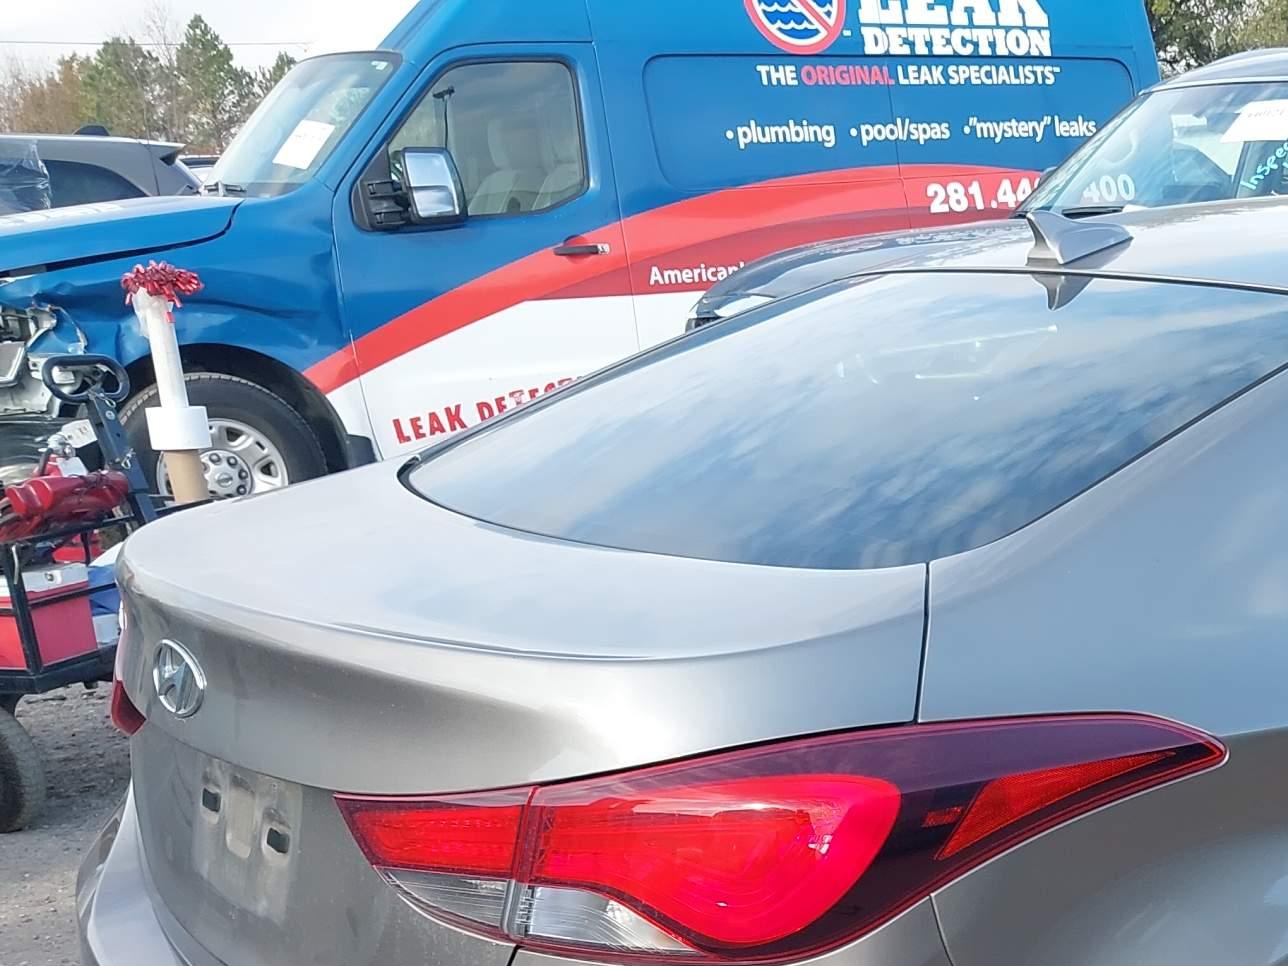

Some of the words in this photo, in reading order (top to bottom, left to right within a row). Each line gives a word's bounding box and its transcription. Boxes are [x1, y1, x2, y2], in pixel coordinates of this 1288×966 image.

[860, 26, 1051, 56] DETECTION
[756, 65, 798, 86] THE
[801, 65, 895, 86] ORIGINAL
[897, 65, 946, 85] LEAK
[736, 119, 836, 149] plumbing
[860, 117, 950, 146] pool/spas
[1054, 115, 1097, 137] leaks
[926, 177, 1041, 214] 281.44
[392, 402, 468, 445] LEAK
